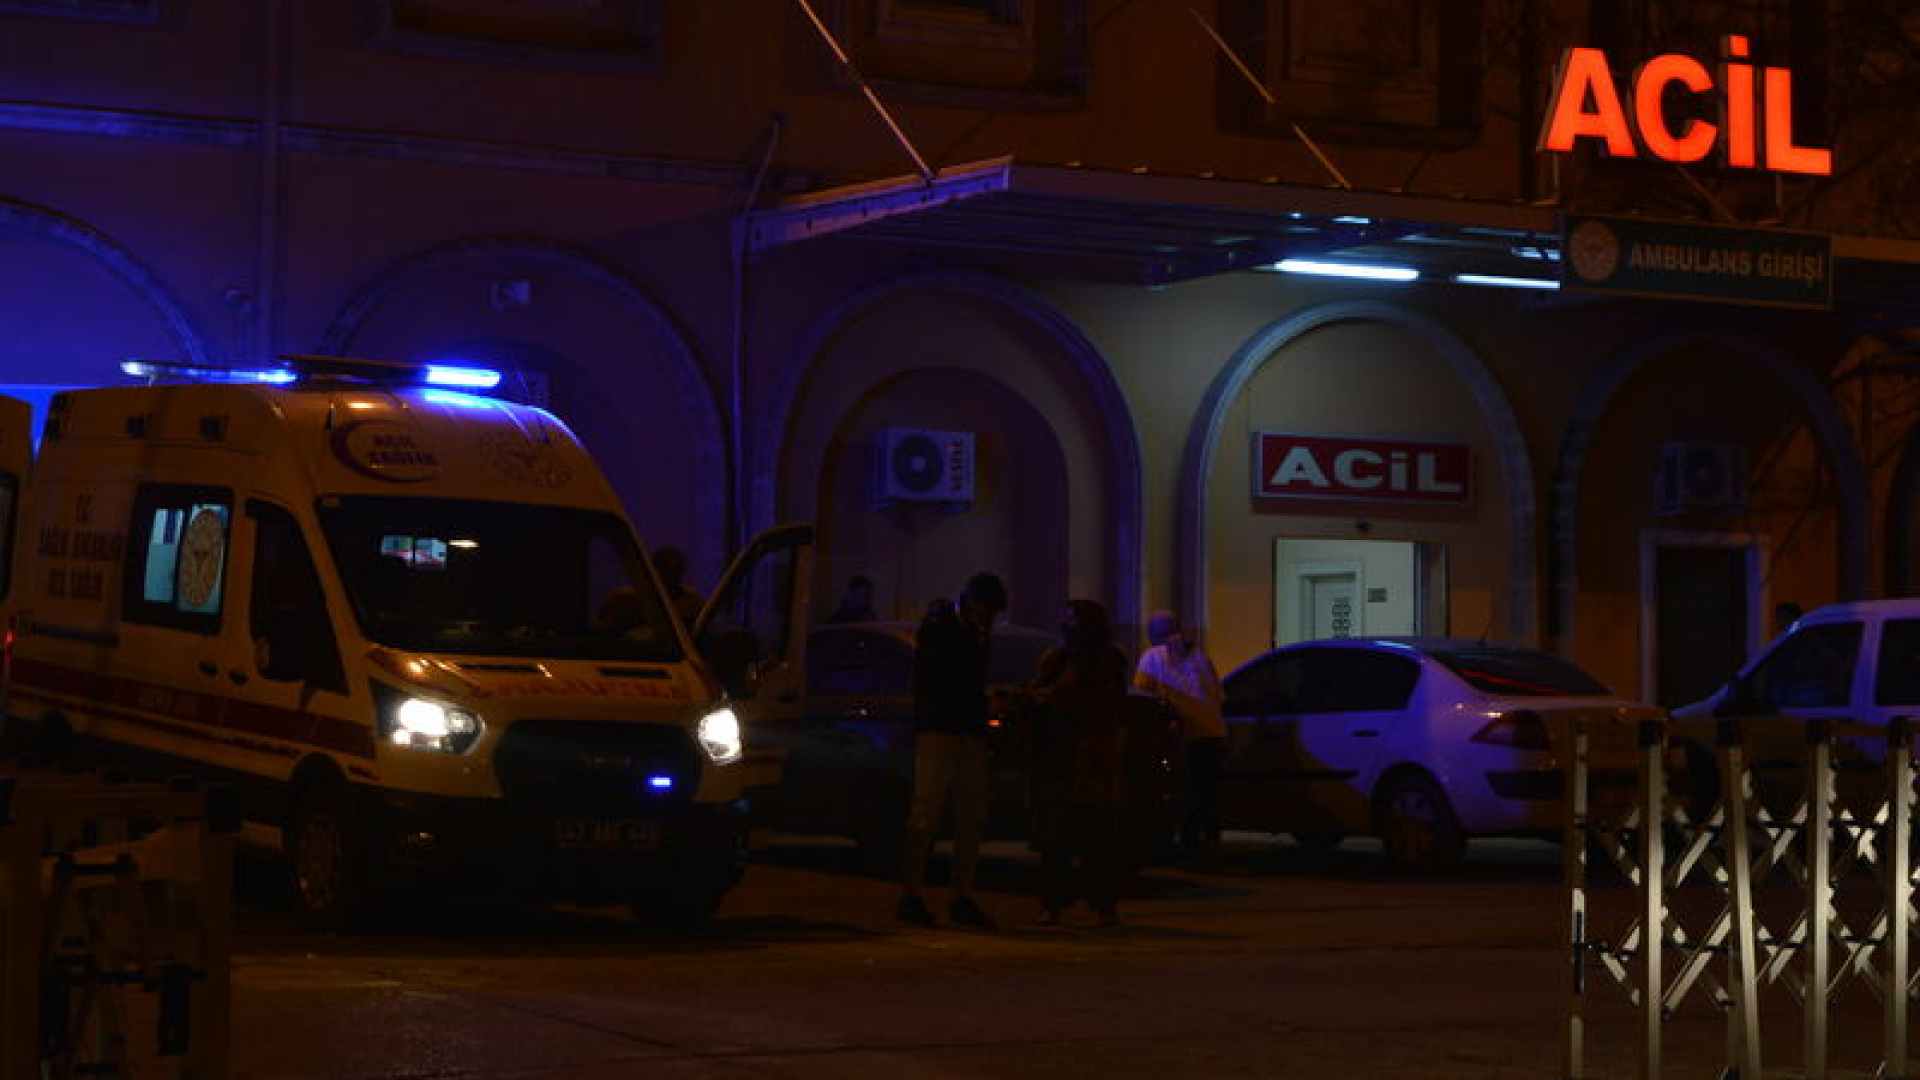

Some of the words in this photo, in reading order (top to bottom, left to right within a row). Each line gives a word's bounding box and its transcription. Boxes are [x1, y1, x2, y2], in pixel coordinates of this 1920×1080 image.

[1541, 35, 1832, 176] ACİL
[1629, 242, 1752, 277] AMBULANS
[1758, 250, 1825, 288] GİRİŞİ
